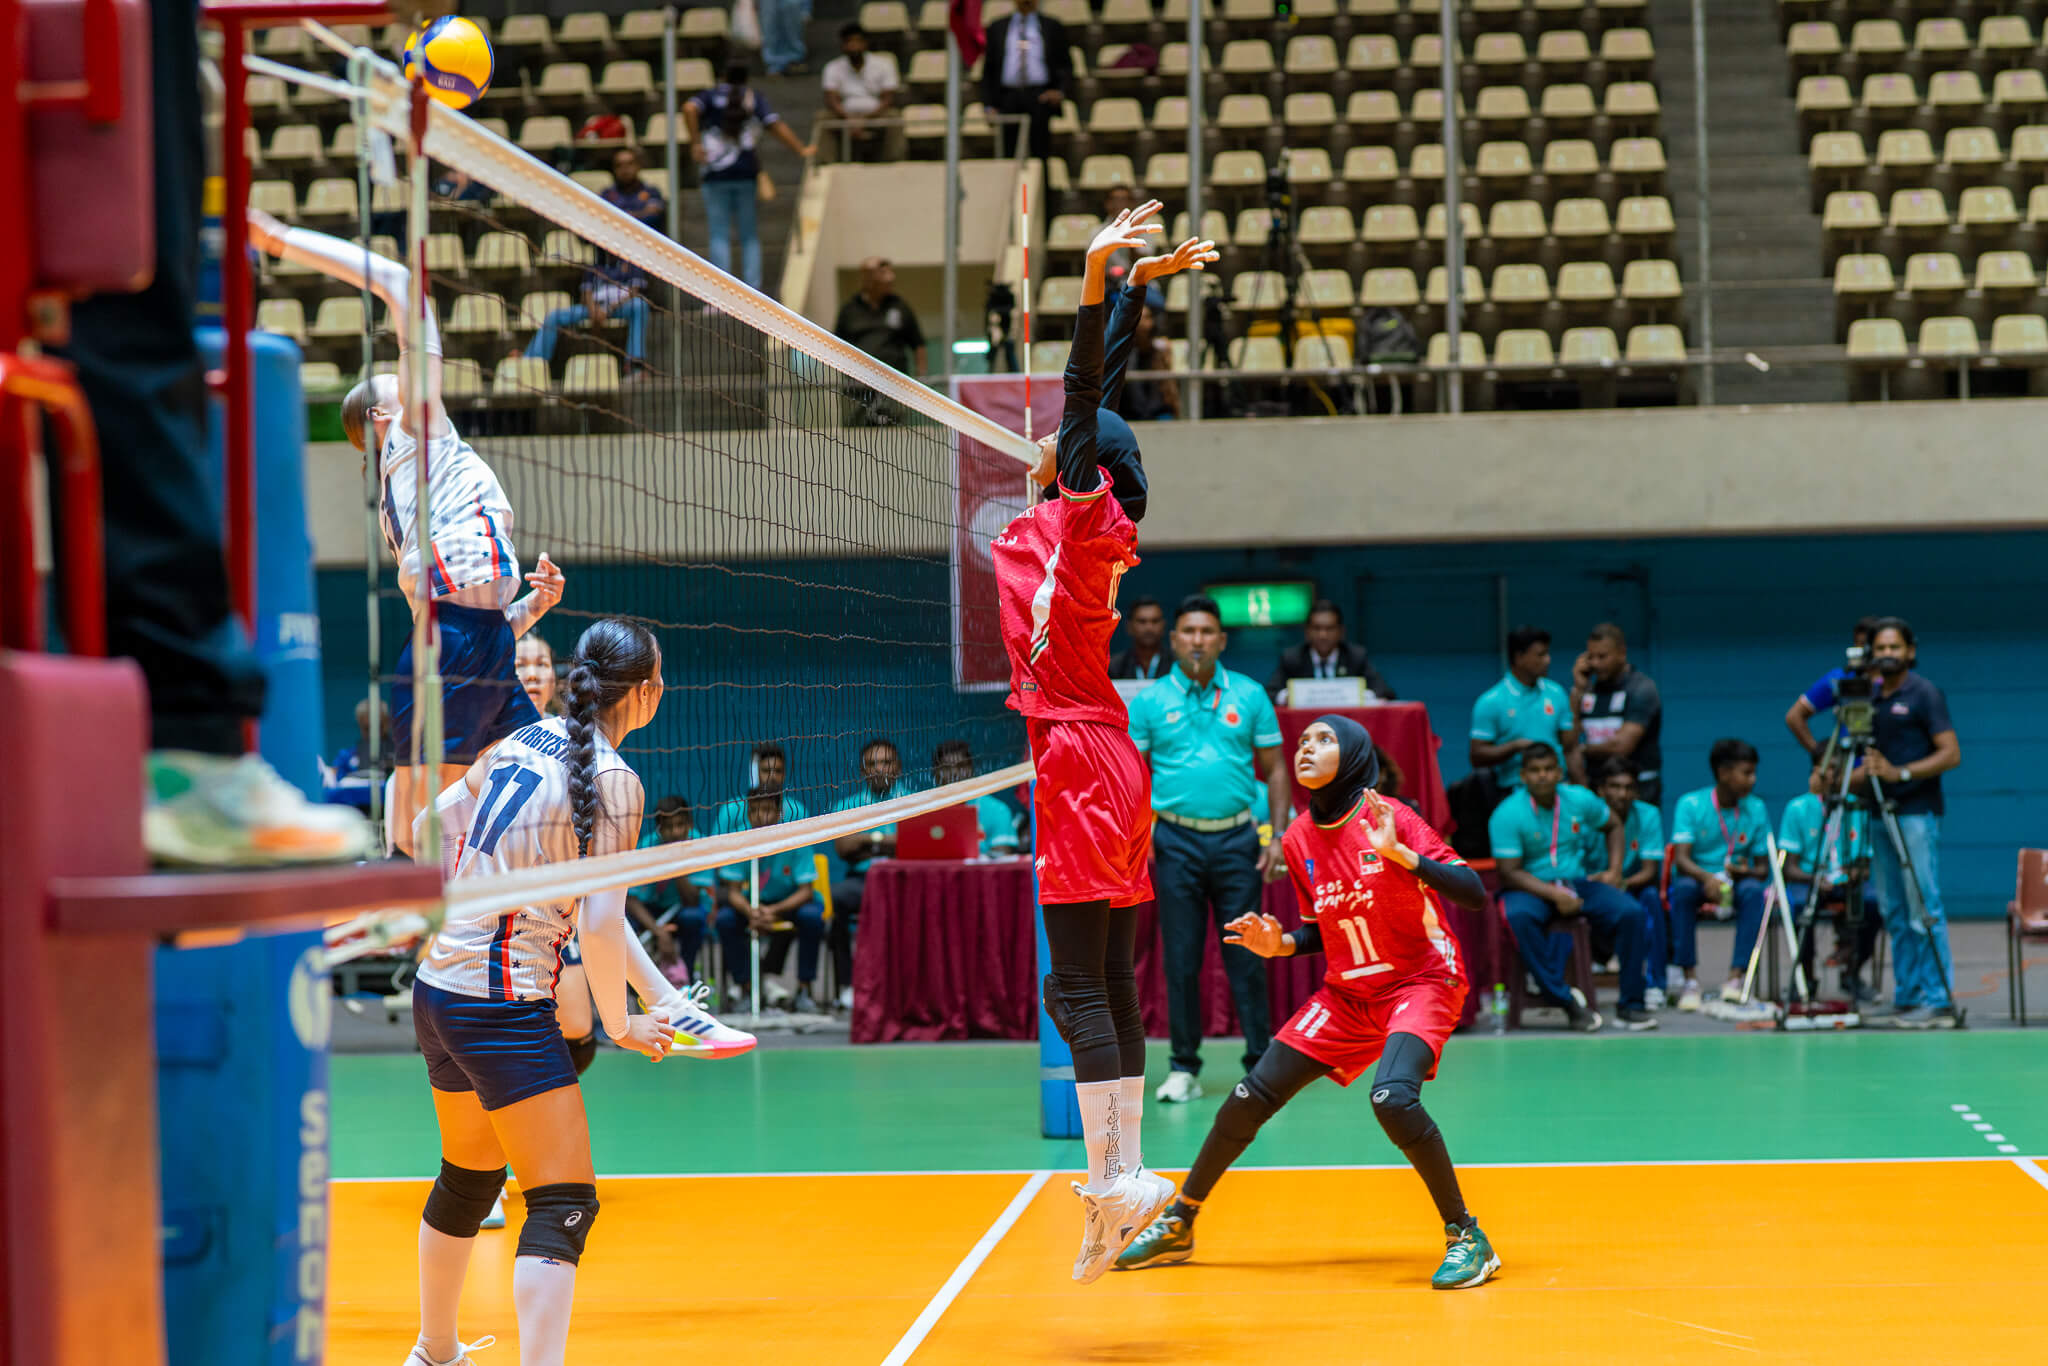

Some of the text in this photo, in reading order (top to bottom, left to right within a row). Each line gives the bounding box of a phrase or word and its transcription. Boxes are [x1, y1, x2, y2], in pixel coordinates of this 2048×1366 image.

[468, 763, 544, 857] 17
[1338, 916, 1379, 965] 11
[1295, 1003, 1331, 1038] 11
